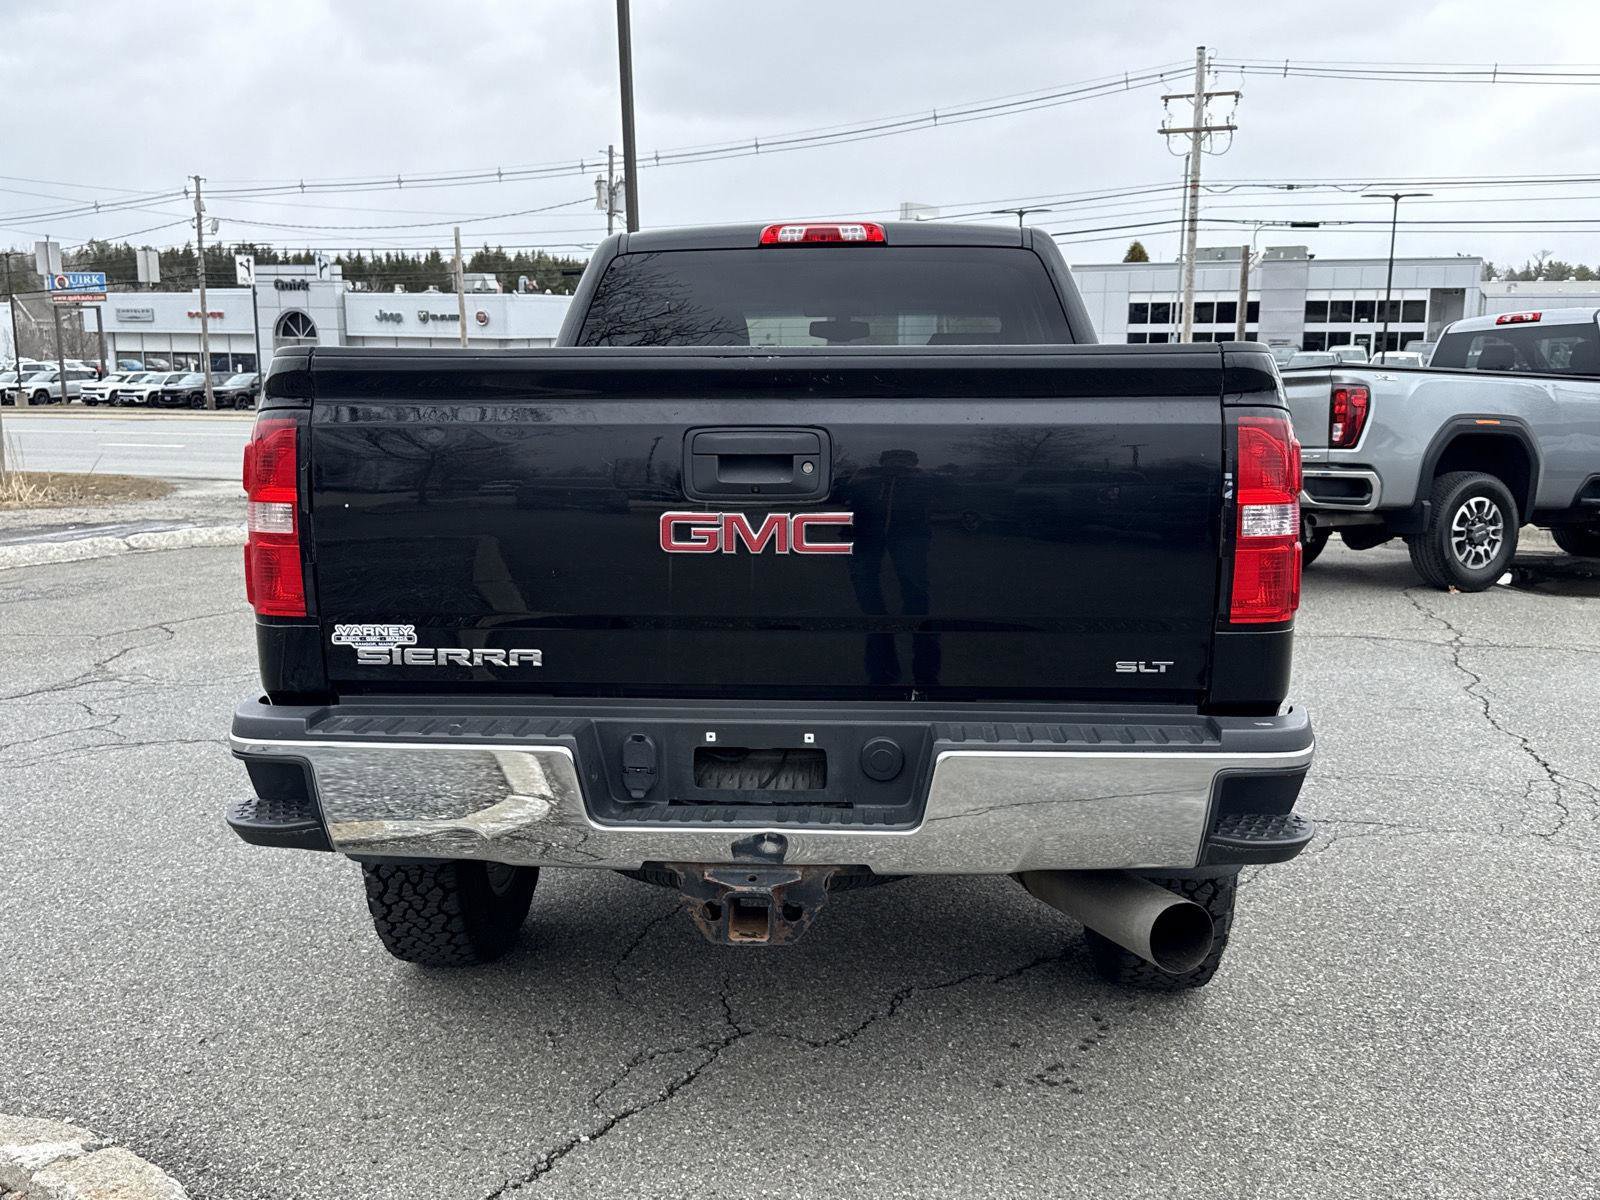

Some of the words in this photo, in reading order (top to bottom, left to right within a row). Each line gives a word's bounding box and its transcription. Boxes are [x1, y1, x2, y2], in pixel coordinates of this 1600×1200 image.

[54, 273, 100, 290] QUIRK
[273, 279, 310, 291] Quirk
[374, 309, 403, 324] Jeep
[660, 511, 854, 555] GMC
[336, 626, 413, 637] VARNEY
[357, 648, 543, 667] SIERRA
[1115, 661, 1174, 673] SLT
